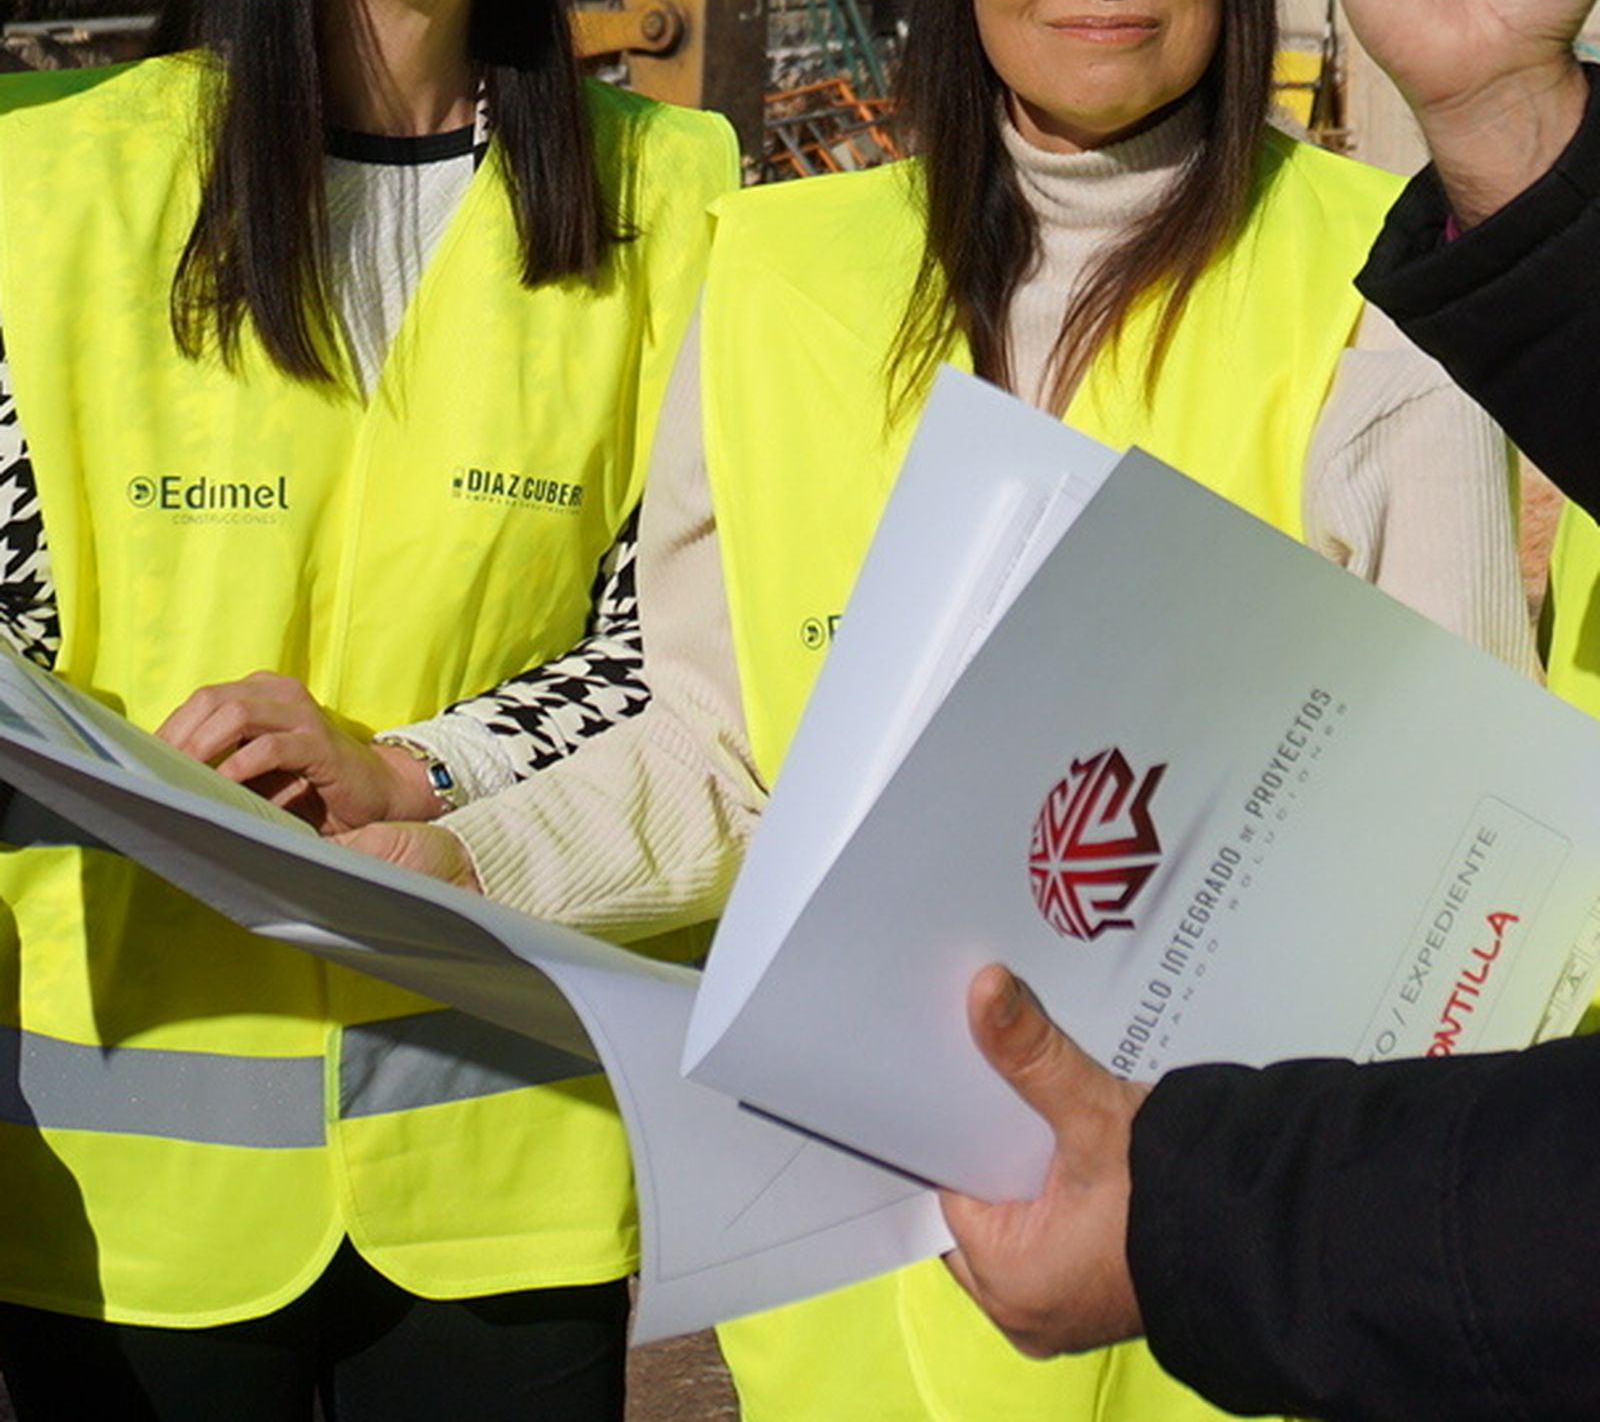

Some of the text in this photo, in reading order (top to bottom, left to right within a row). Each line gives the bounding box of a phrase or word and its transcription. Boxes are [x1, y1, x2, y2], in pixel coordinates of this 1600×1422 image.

[160, 475, 289, 510] Edimel
[1111, 979, 1173, 1081] RROLLO
[1160, 846, 1242, 975] INTEGRADO
[1244, 688, 1332, 820] PROYECTOS
[1400, 825, 1498, 1006] EXPEDIENTE
